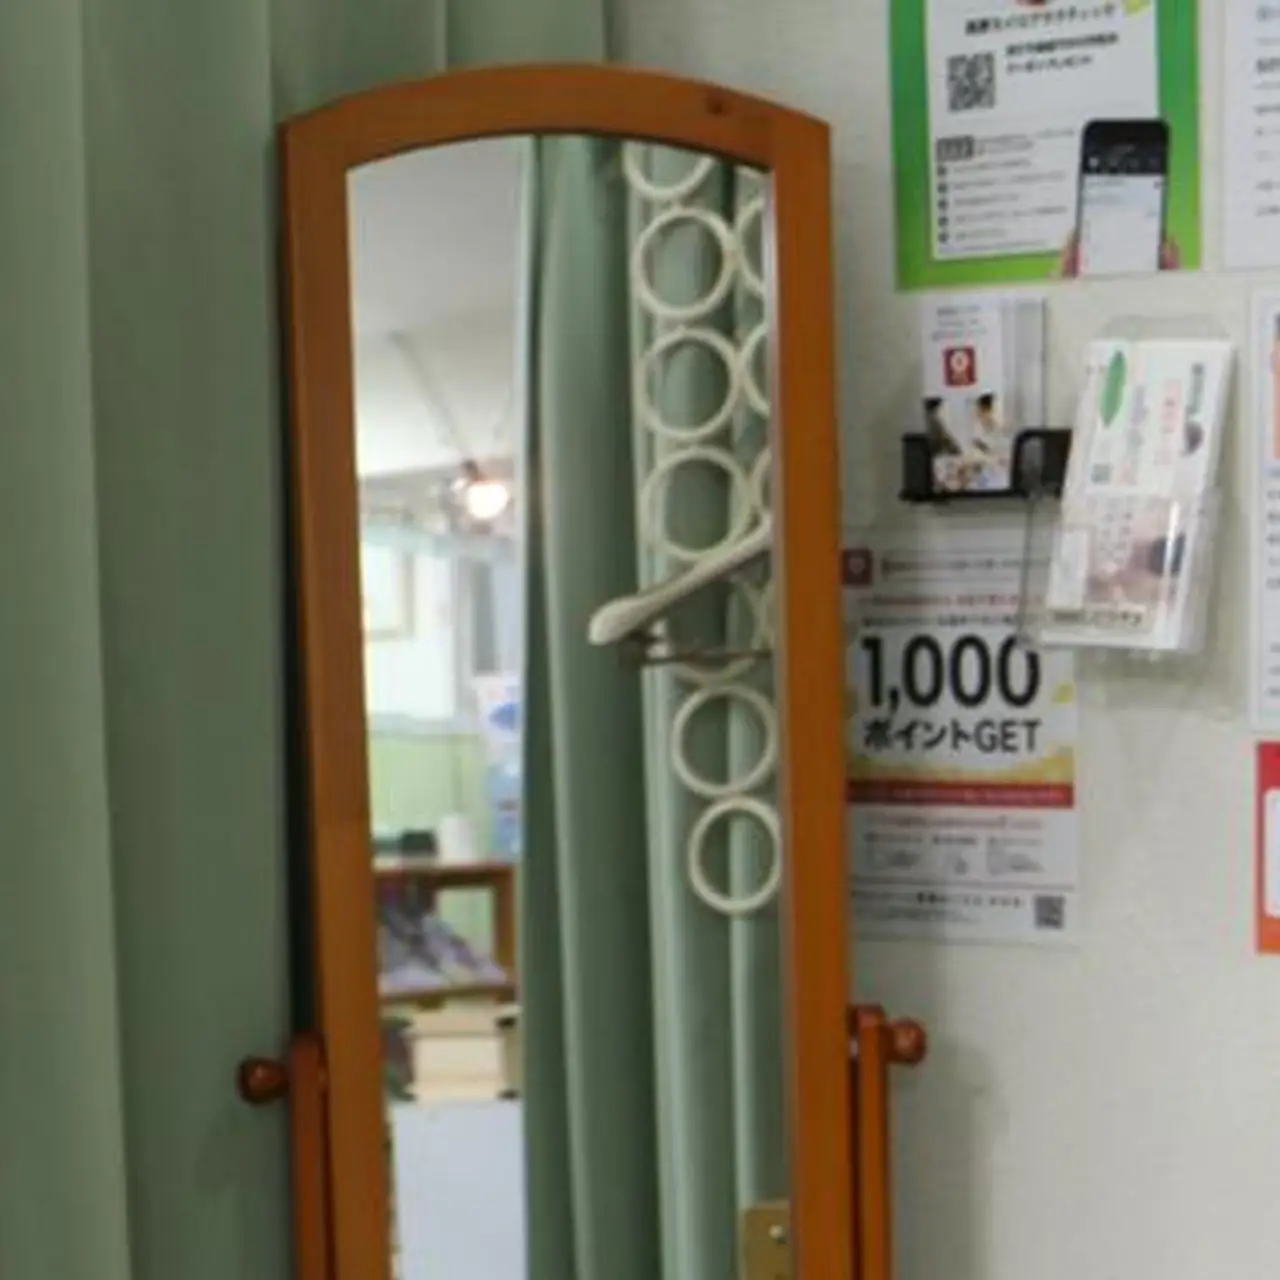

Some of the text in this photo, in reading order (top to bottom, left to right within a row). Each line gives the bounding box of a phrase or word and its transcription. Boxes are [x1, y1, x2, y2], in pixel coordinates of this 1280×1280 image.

[860, 632, 1041, 715] 1,000
[862, 718, 1043, 754] ポイントGET
